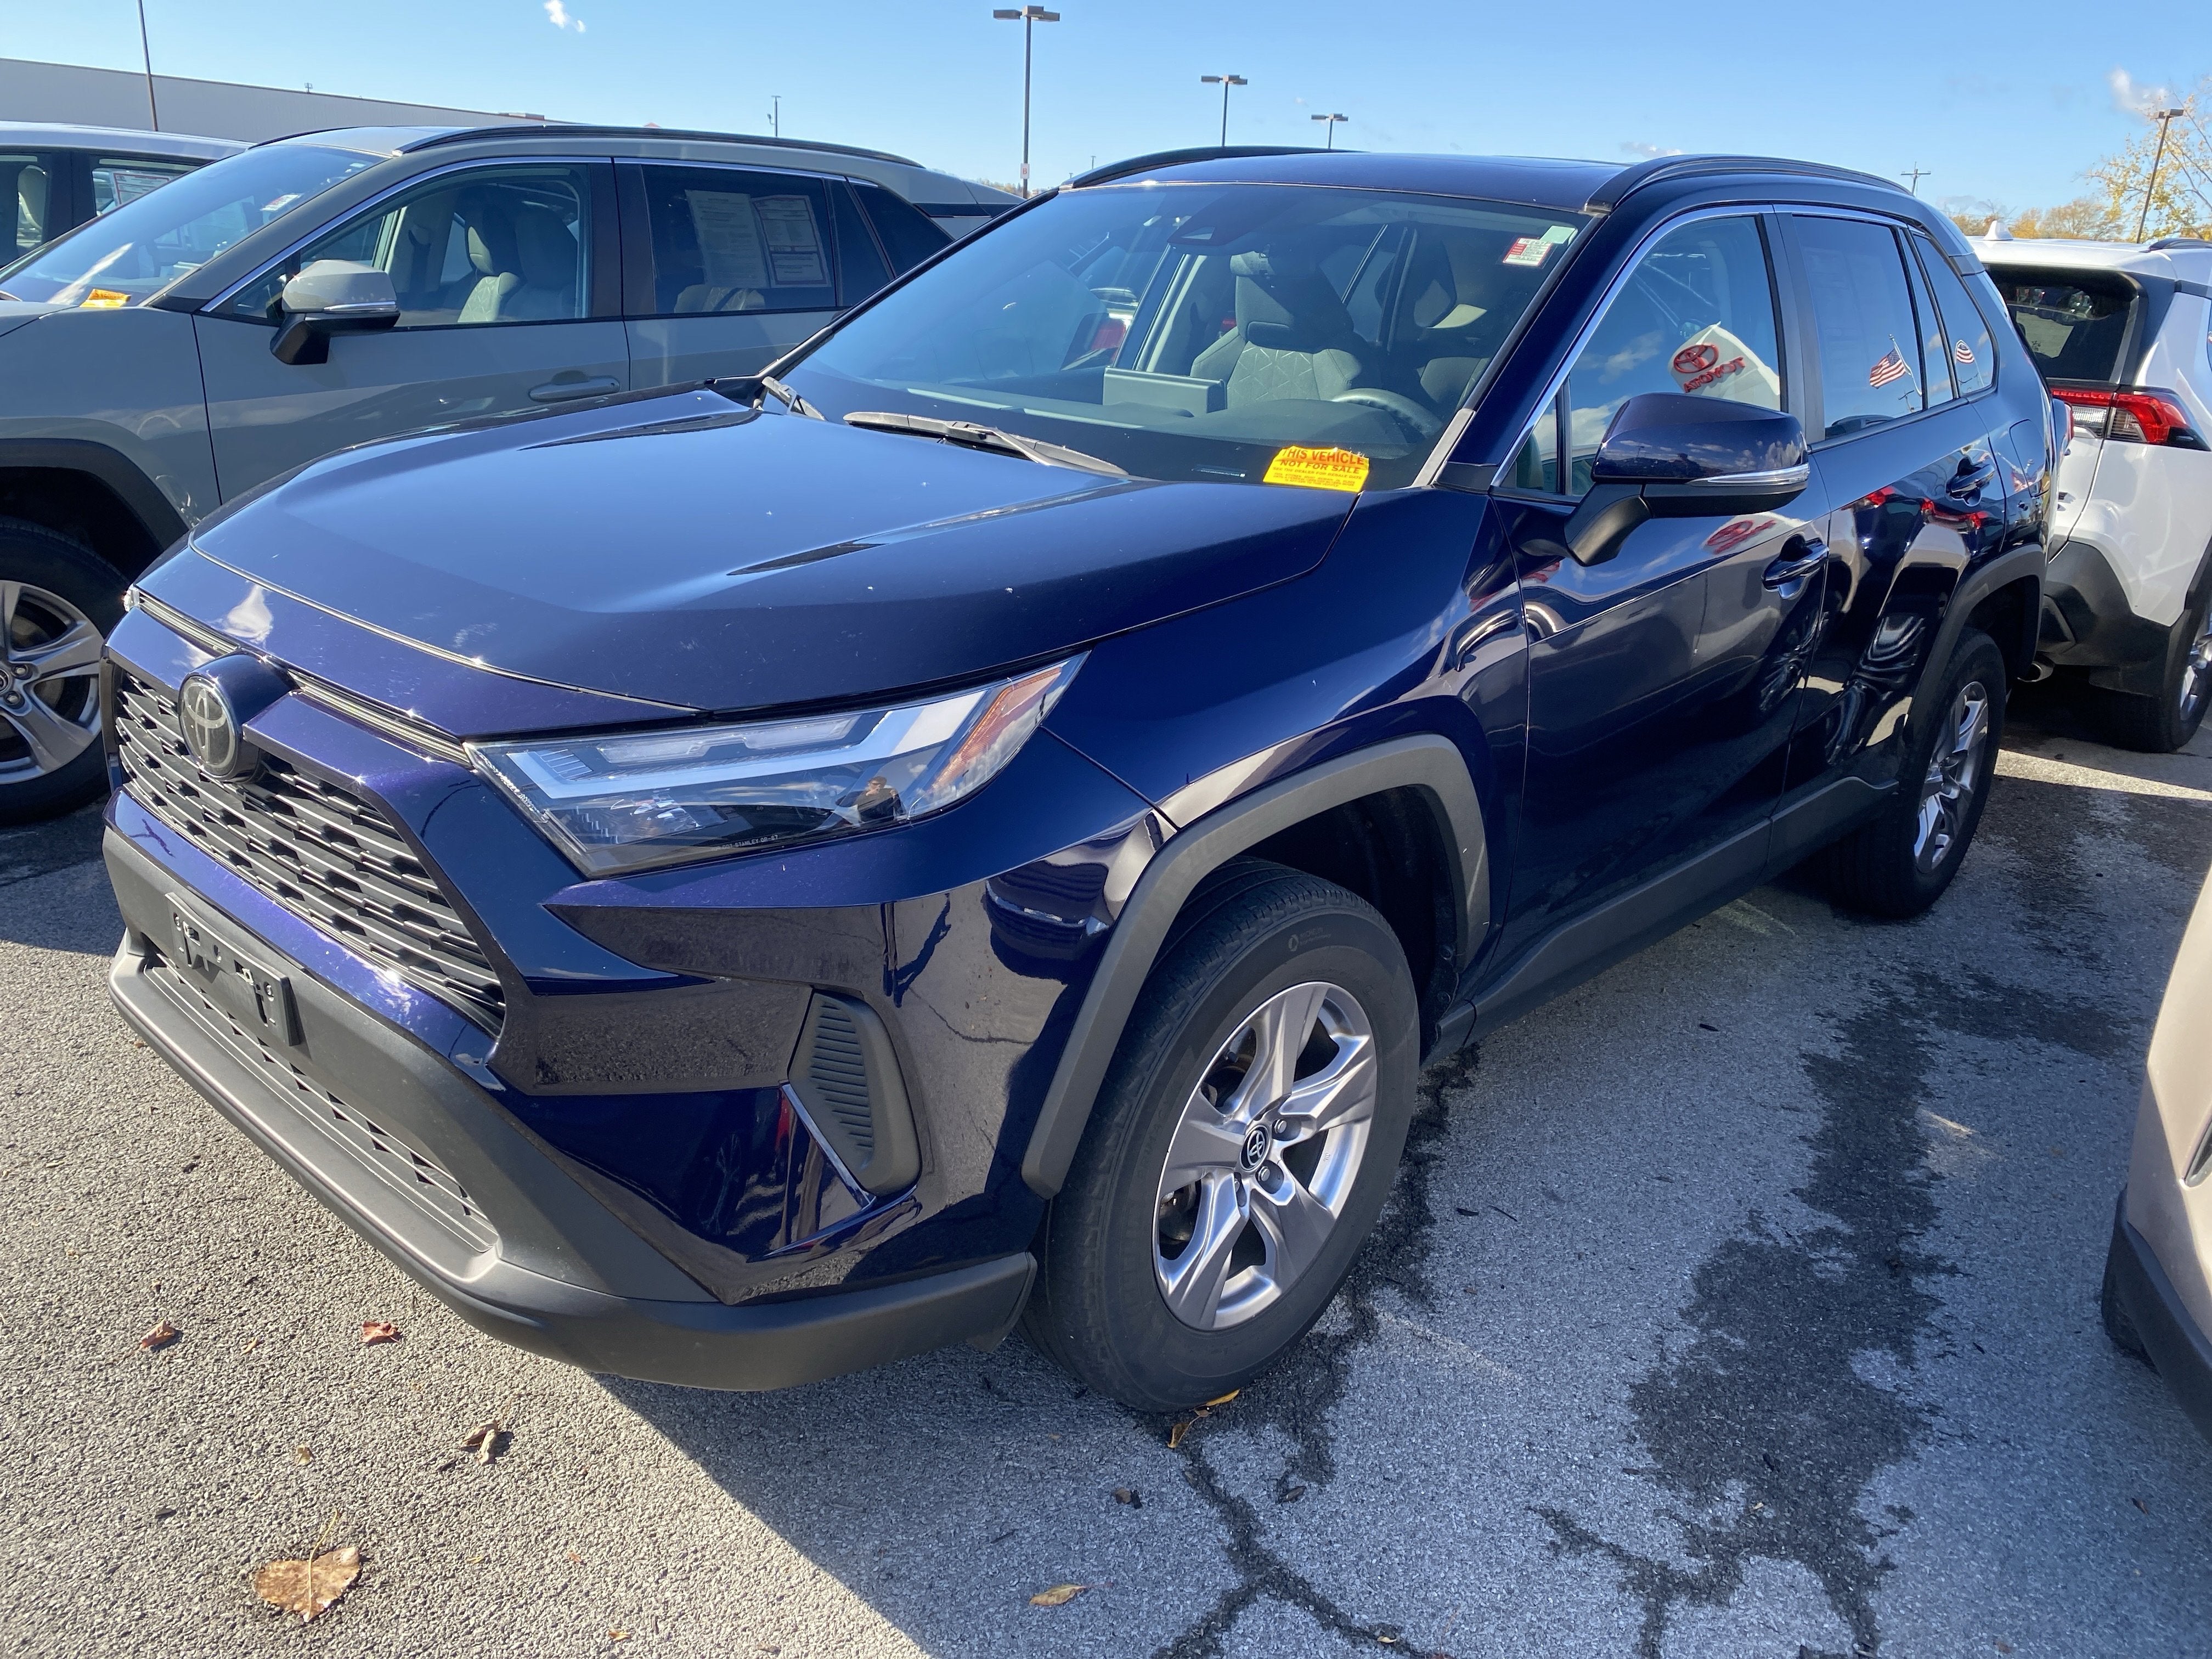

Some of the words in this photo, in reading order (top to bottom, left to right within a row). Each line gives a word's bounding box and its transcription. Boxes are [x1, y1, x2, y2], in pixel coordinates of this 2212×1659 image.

[1312, 450, 1364, 465] VEHICLE
[1280, 459, 1304, 467] NOT
[1305, 461, 1328, 470] FOR
[1331, 464, 1361, 474] SALE
[735, 838, 758, 848] STANLEY
